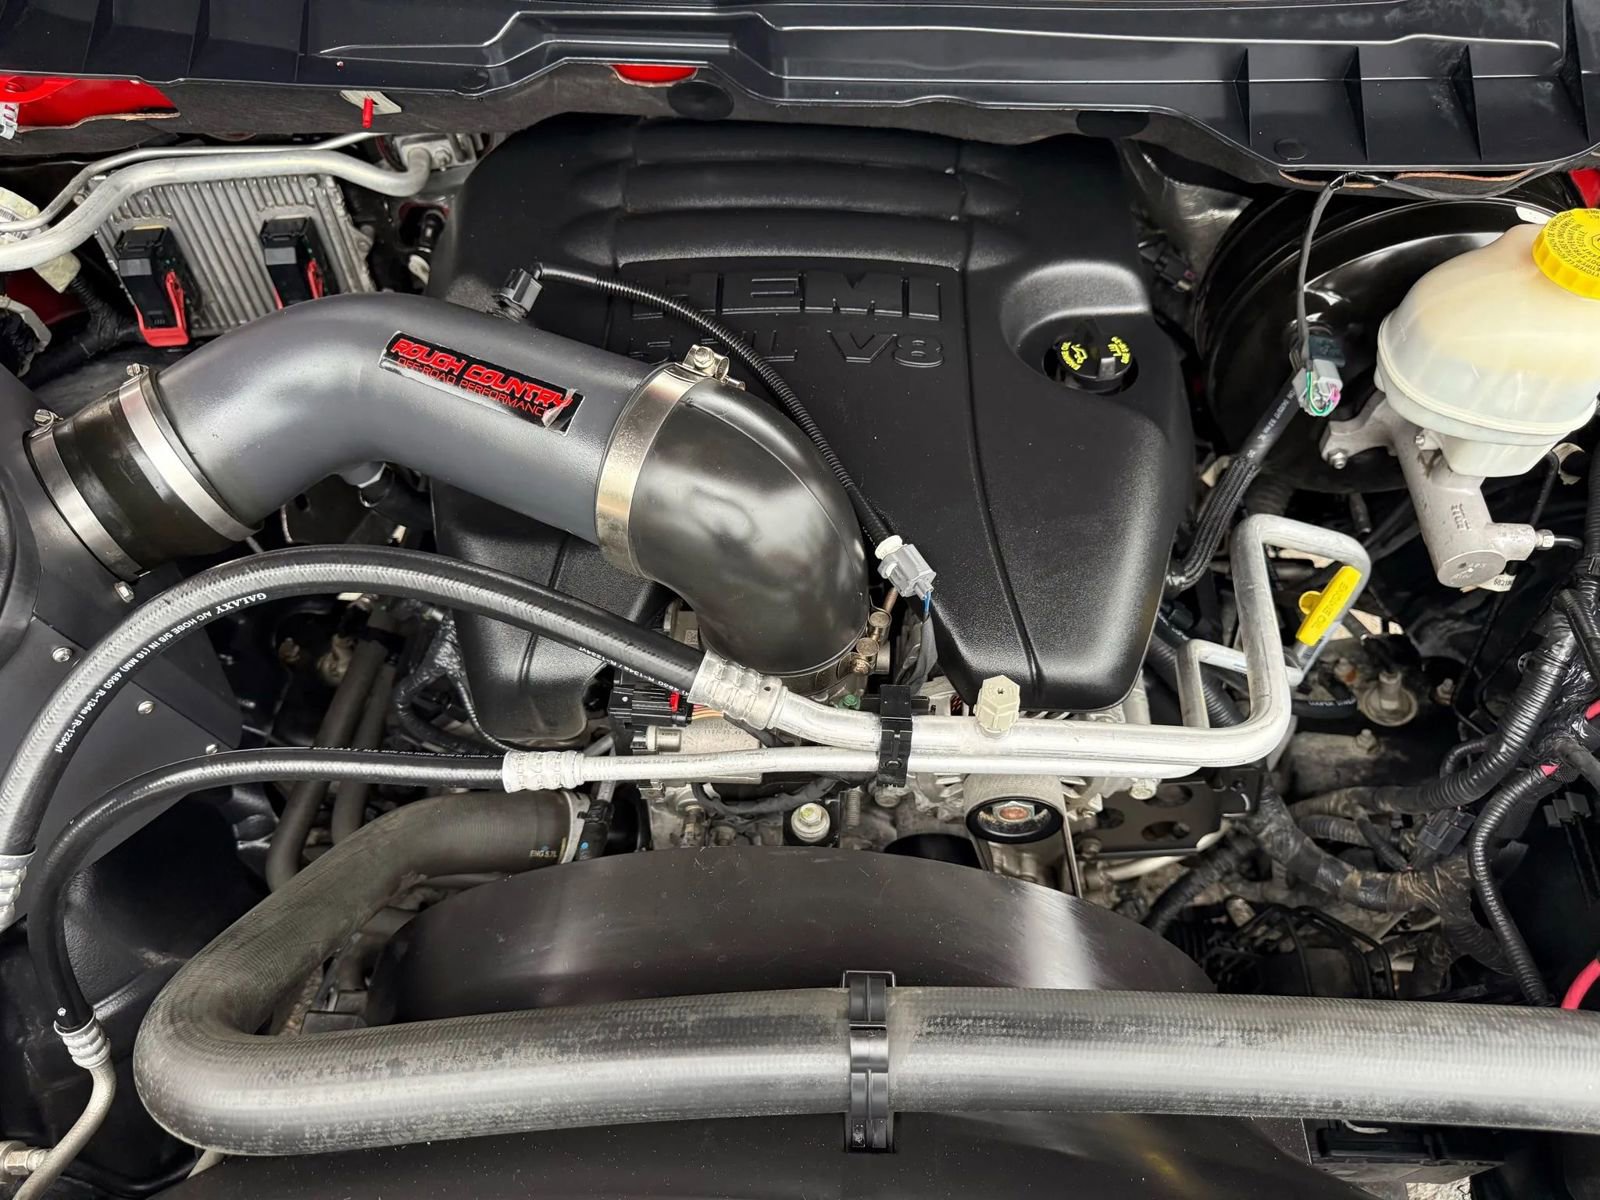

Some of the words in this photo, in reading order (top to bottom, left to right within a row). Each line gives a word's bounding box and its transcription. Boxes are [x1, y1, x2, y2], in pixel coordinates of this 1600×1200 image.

[825, 328, 945, 369] V8
[390, 338, 465, 375] ROUGH
[463, 364, 573, 408] COUNTRY
[396, 357, 456, 386] OFF-ROAD
[459, 379, 549, 417] PERFORMANC
[215, 591, 267, 614] GALAXY
[157, 629, 173, 643] 5/8
[172, 615, 198, 635] HOSE
[148, 638, 161, 651] IN
